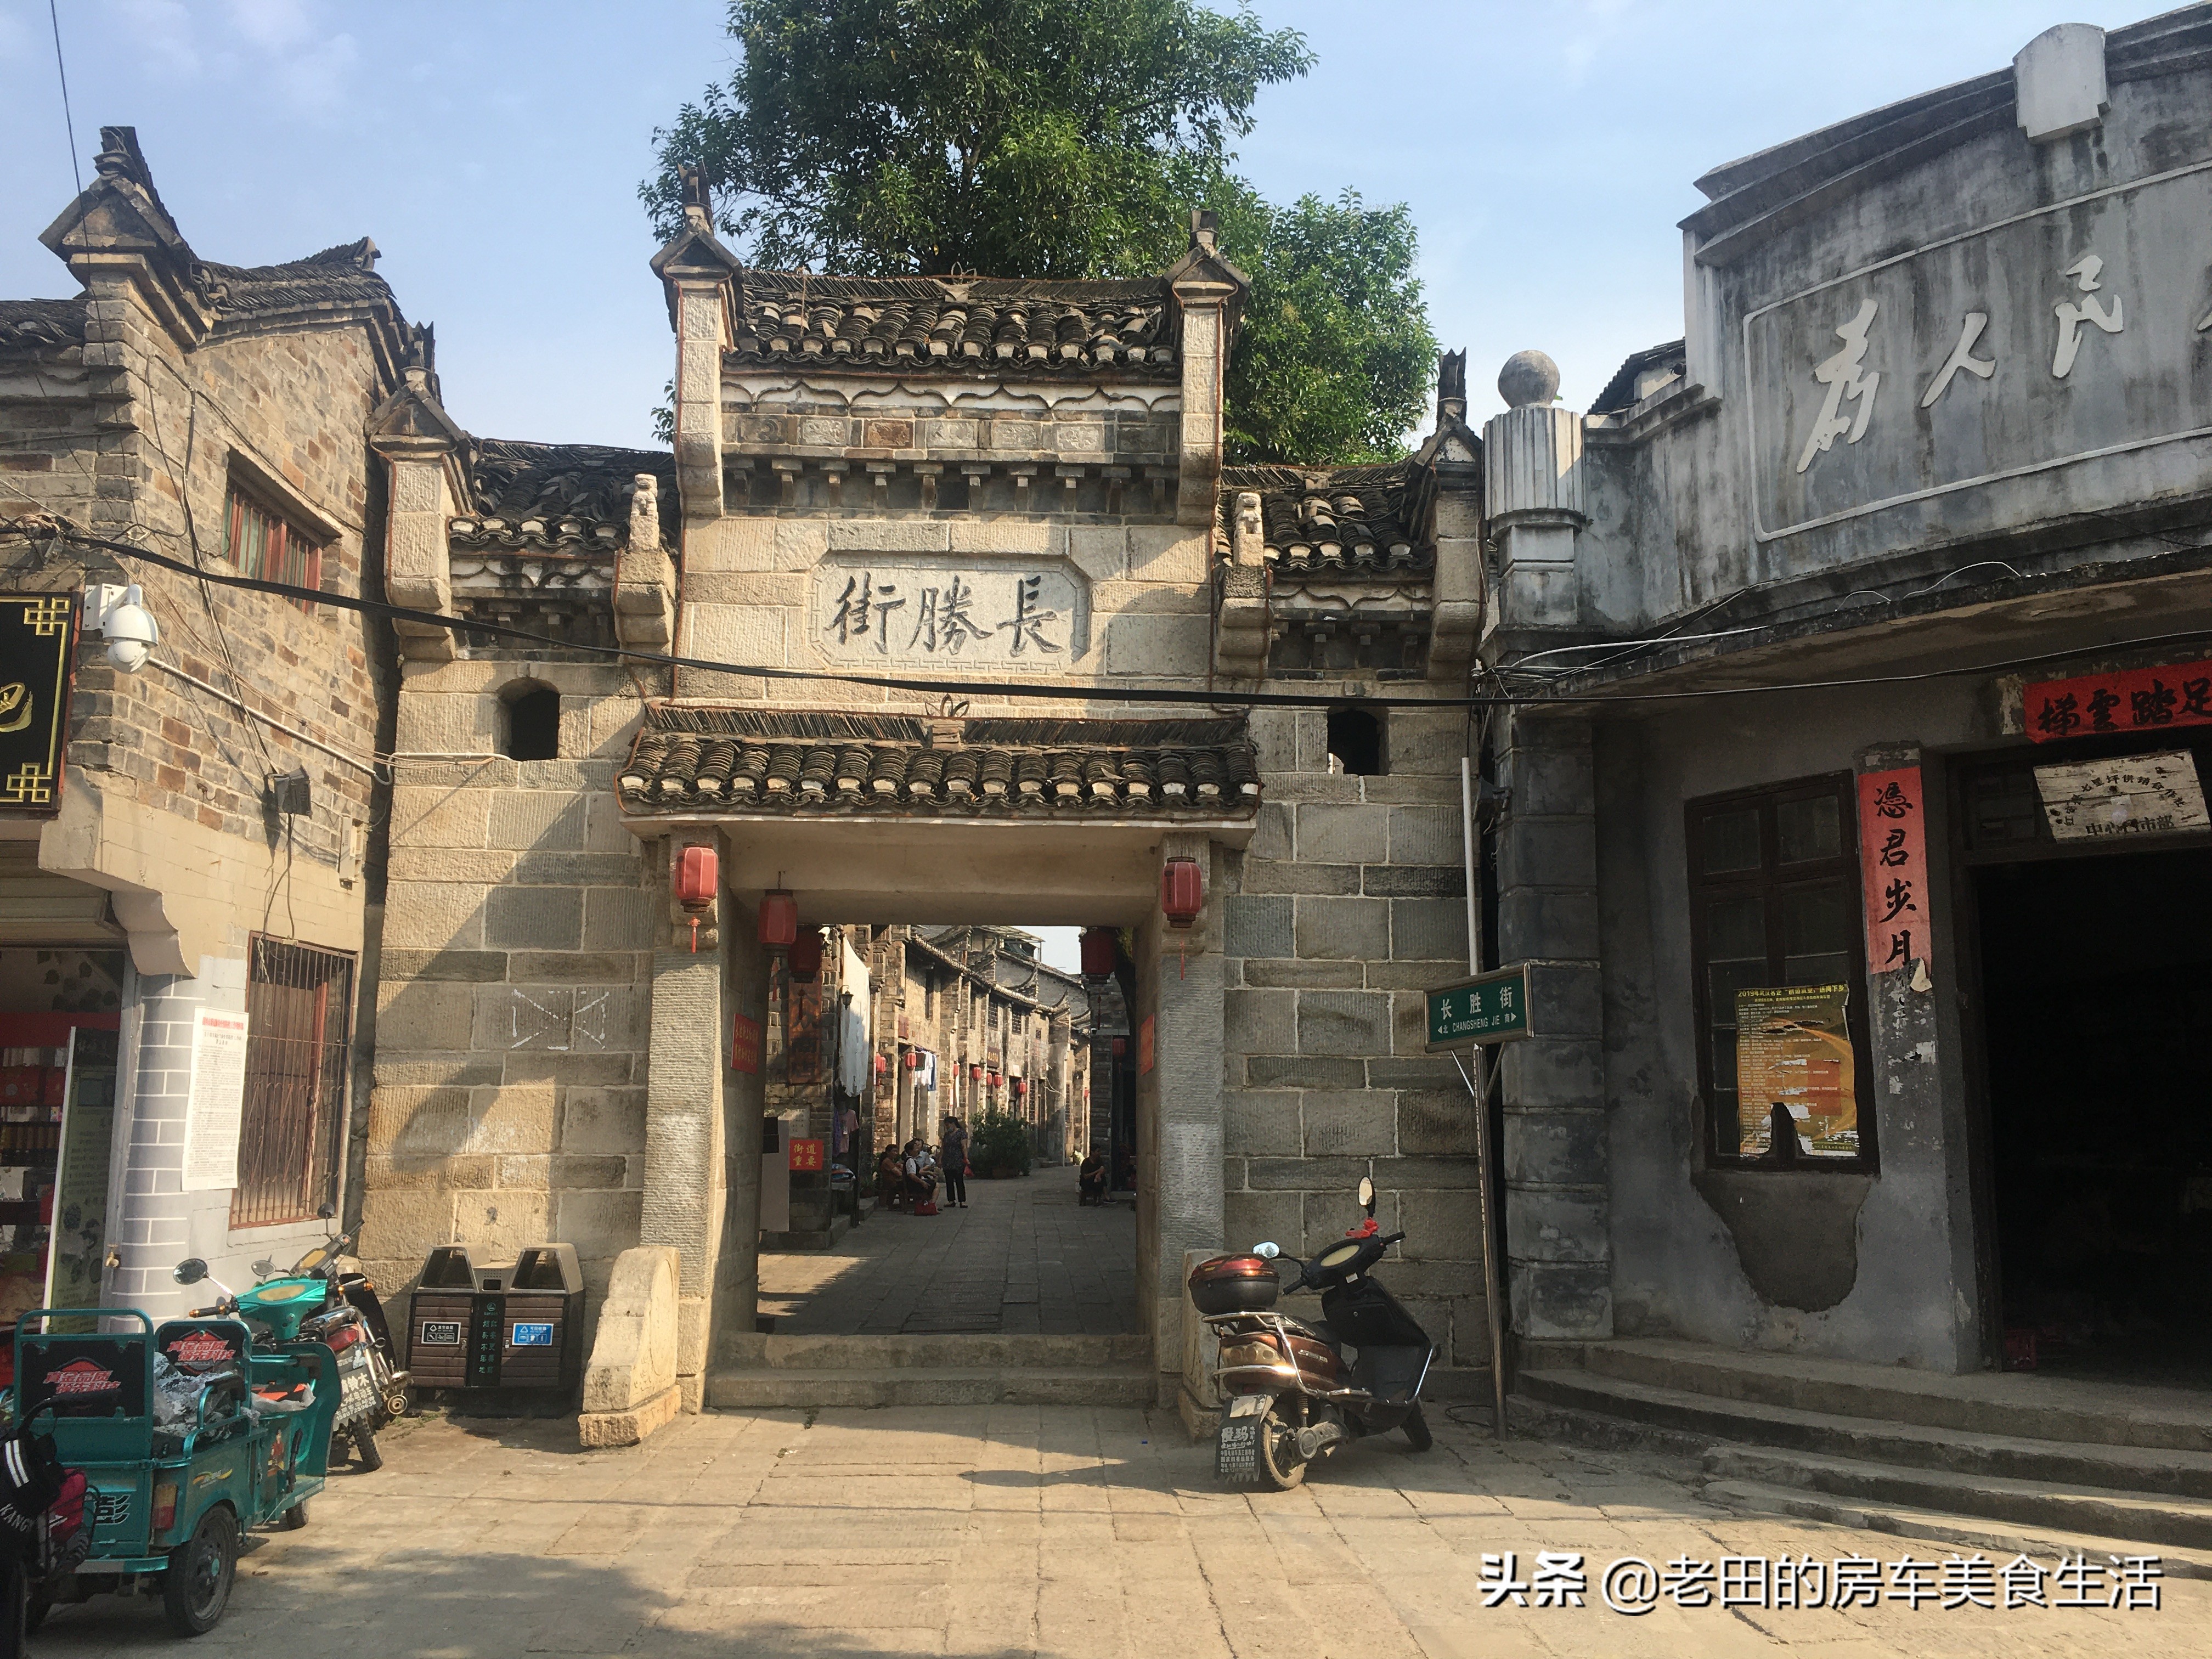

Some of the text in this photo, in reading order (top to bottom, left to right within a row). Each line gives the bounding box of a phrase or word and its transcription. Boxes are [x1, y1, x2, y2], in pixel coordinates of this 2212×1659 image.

[1796, 255, 2212, 473] 为人民
[825, 571, 1064, 657] 長勝街
[1441, 987, 1512, 1020] 长胜街
[1443, 1013, 1510, 1033] 北 CHANGSHENG JIE 南
